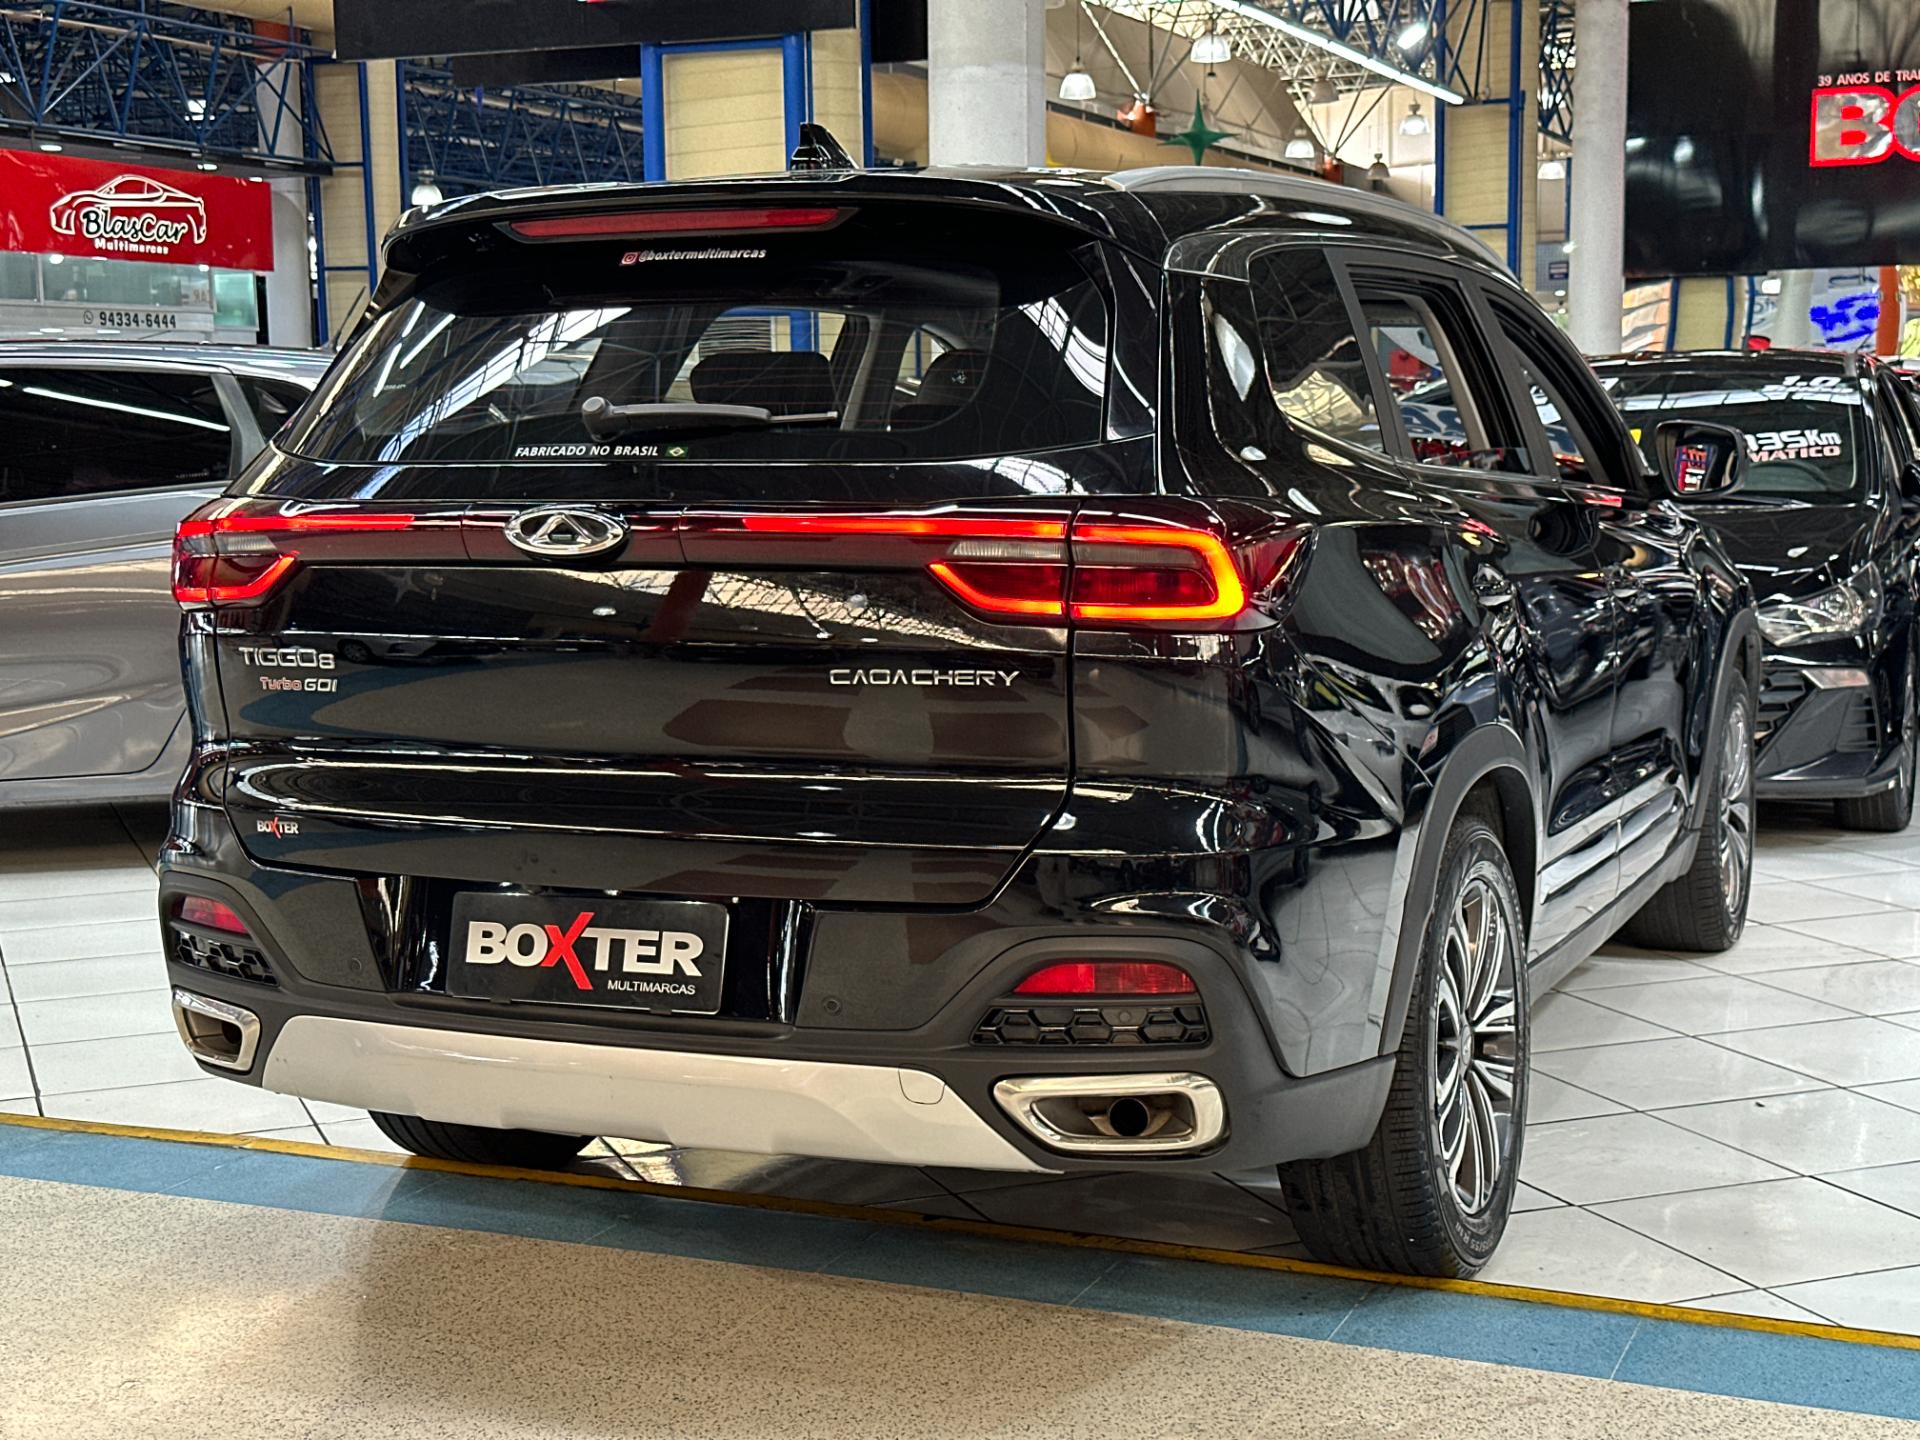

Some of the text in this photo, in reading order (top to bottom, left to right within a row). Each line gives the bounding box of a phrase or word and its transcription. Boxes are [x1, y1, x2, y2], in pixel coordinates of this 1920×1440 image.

[1817, 69, 1920, 87] 39 ANOS DE TRA
[81, 206, 187, 243] BlasCar
[638, 248, 767, 262] @boxtermultimarcas
[99, 311, 177, 328] 94334-6444
[1783, 375, 1841, 388] 1.0
[515, 446, 659, 457] FABRICADO NO BRASIL
[260, 676, 302, 690] Turbo
[256, 816, 299, 839] BOXTER
[465, 912, 704, 990] BOXTER
[607, 980, 696, 995] MULTIMARCAS
